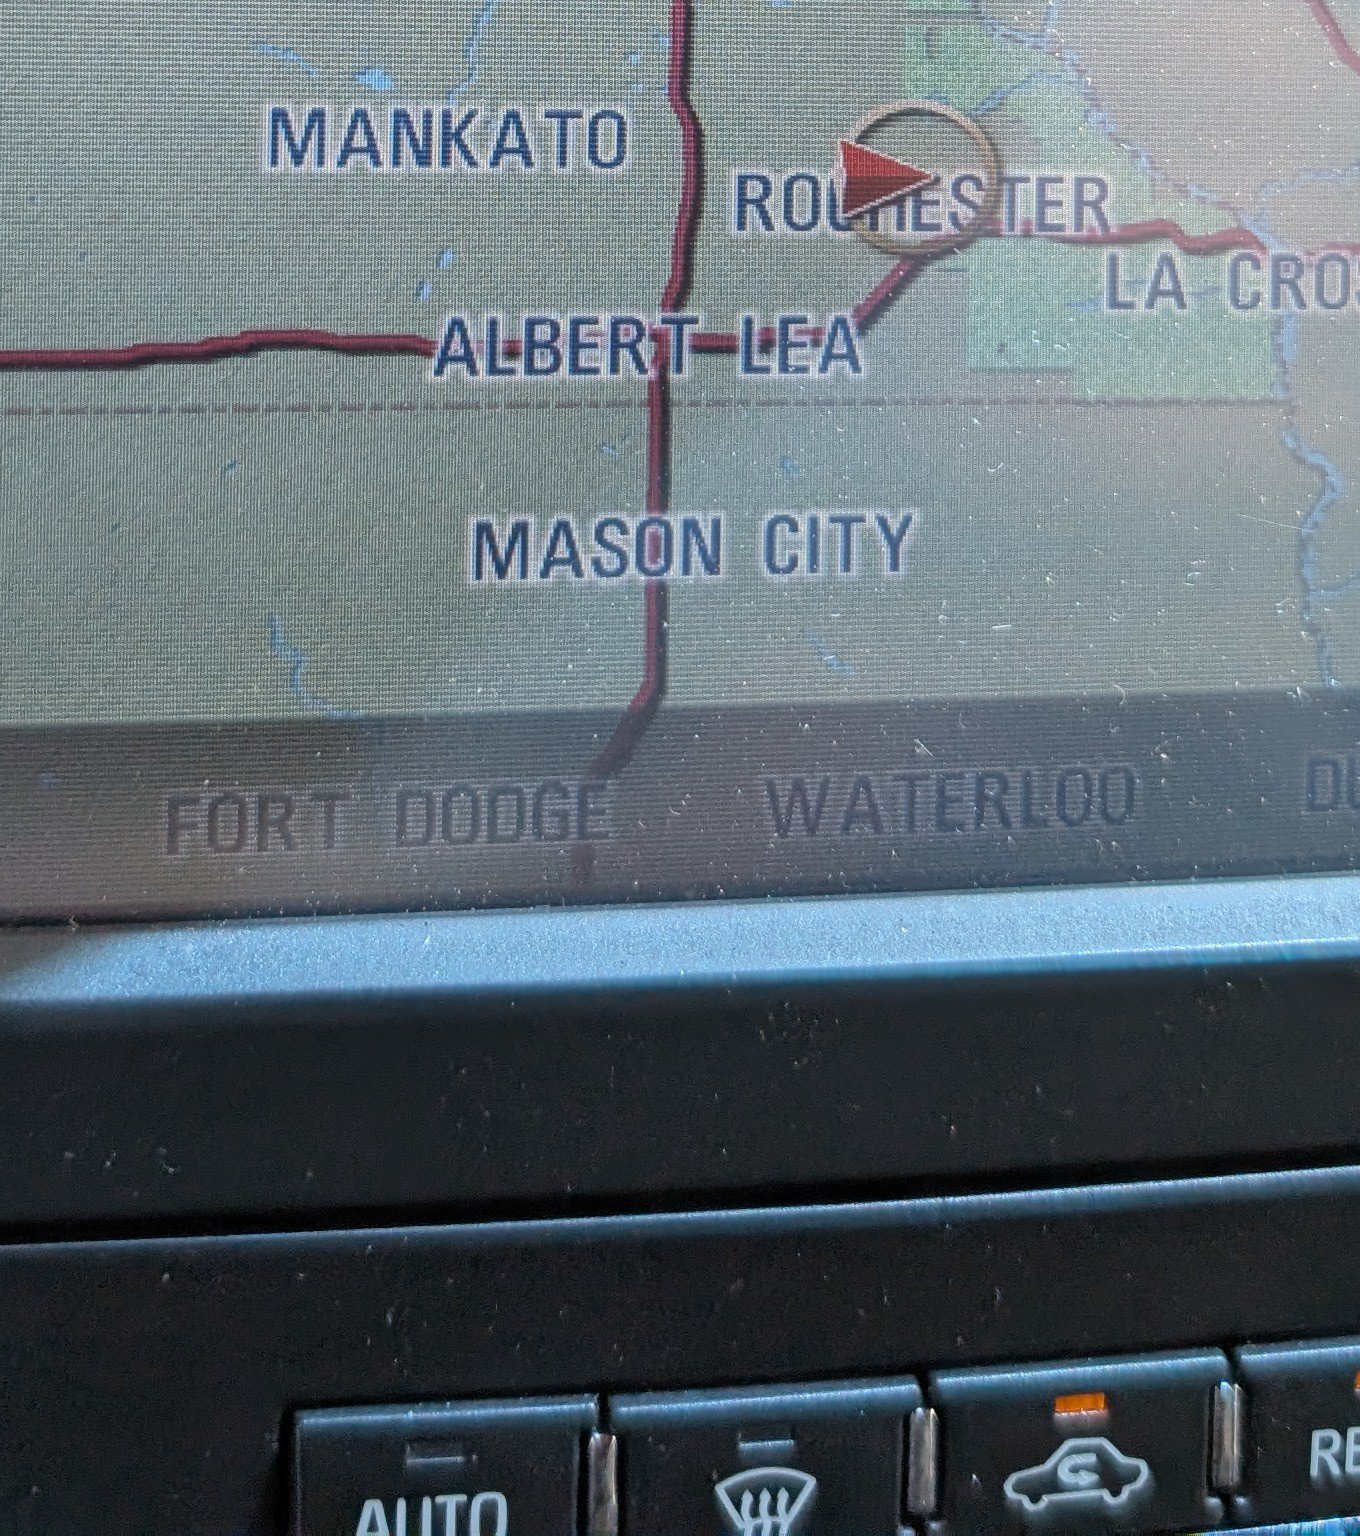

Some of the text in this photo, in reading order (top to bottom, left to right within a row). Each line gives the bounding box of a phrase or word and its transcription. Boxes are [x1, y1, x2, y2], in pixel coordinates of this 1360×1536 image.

[268, 107, 627, 168] MANKATO
[1106, 252, 1187, 311] LA
[433, 316, 863, 377] ALBERT LEA
[473, 514, 915, 580] MASON CITY
[167, 778, 610, 854] FORT DODGE
[767, 767, 1138, 838] WATERLOO
